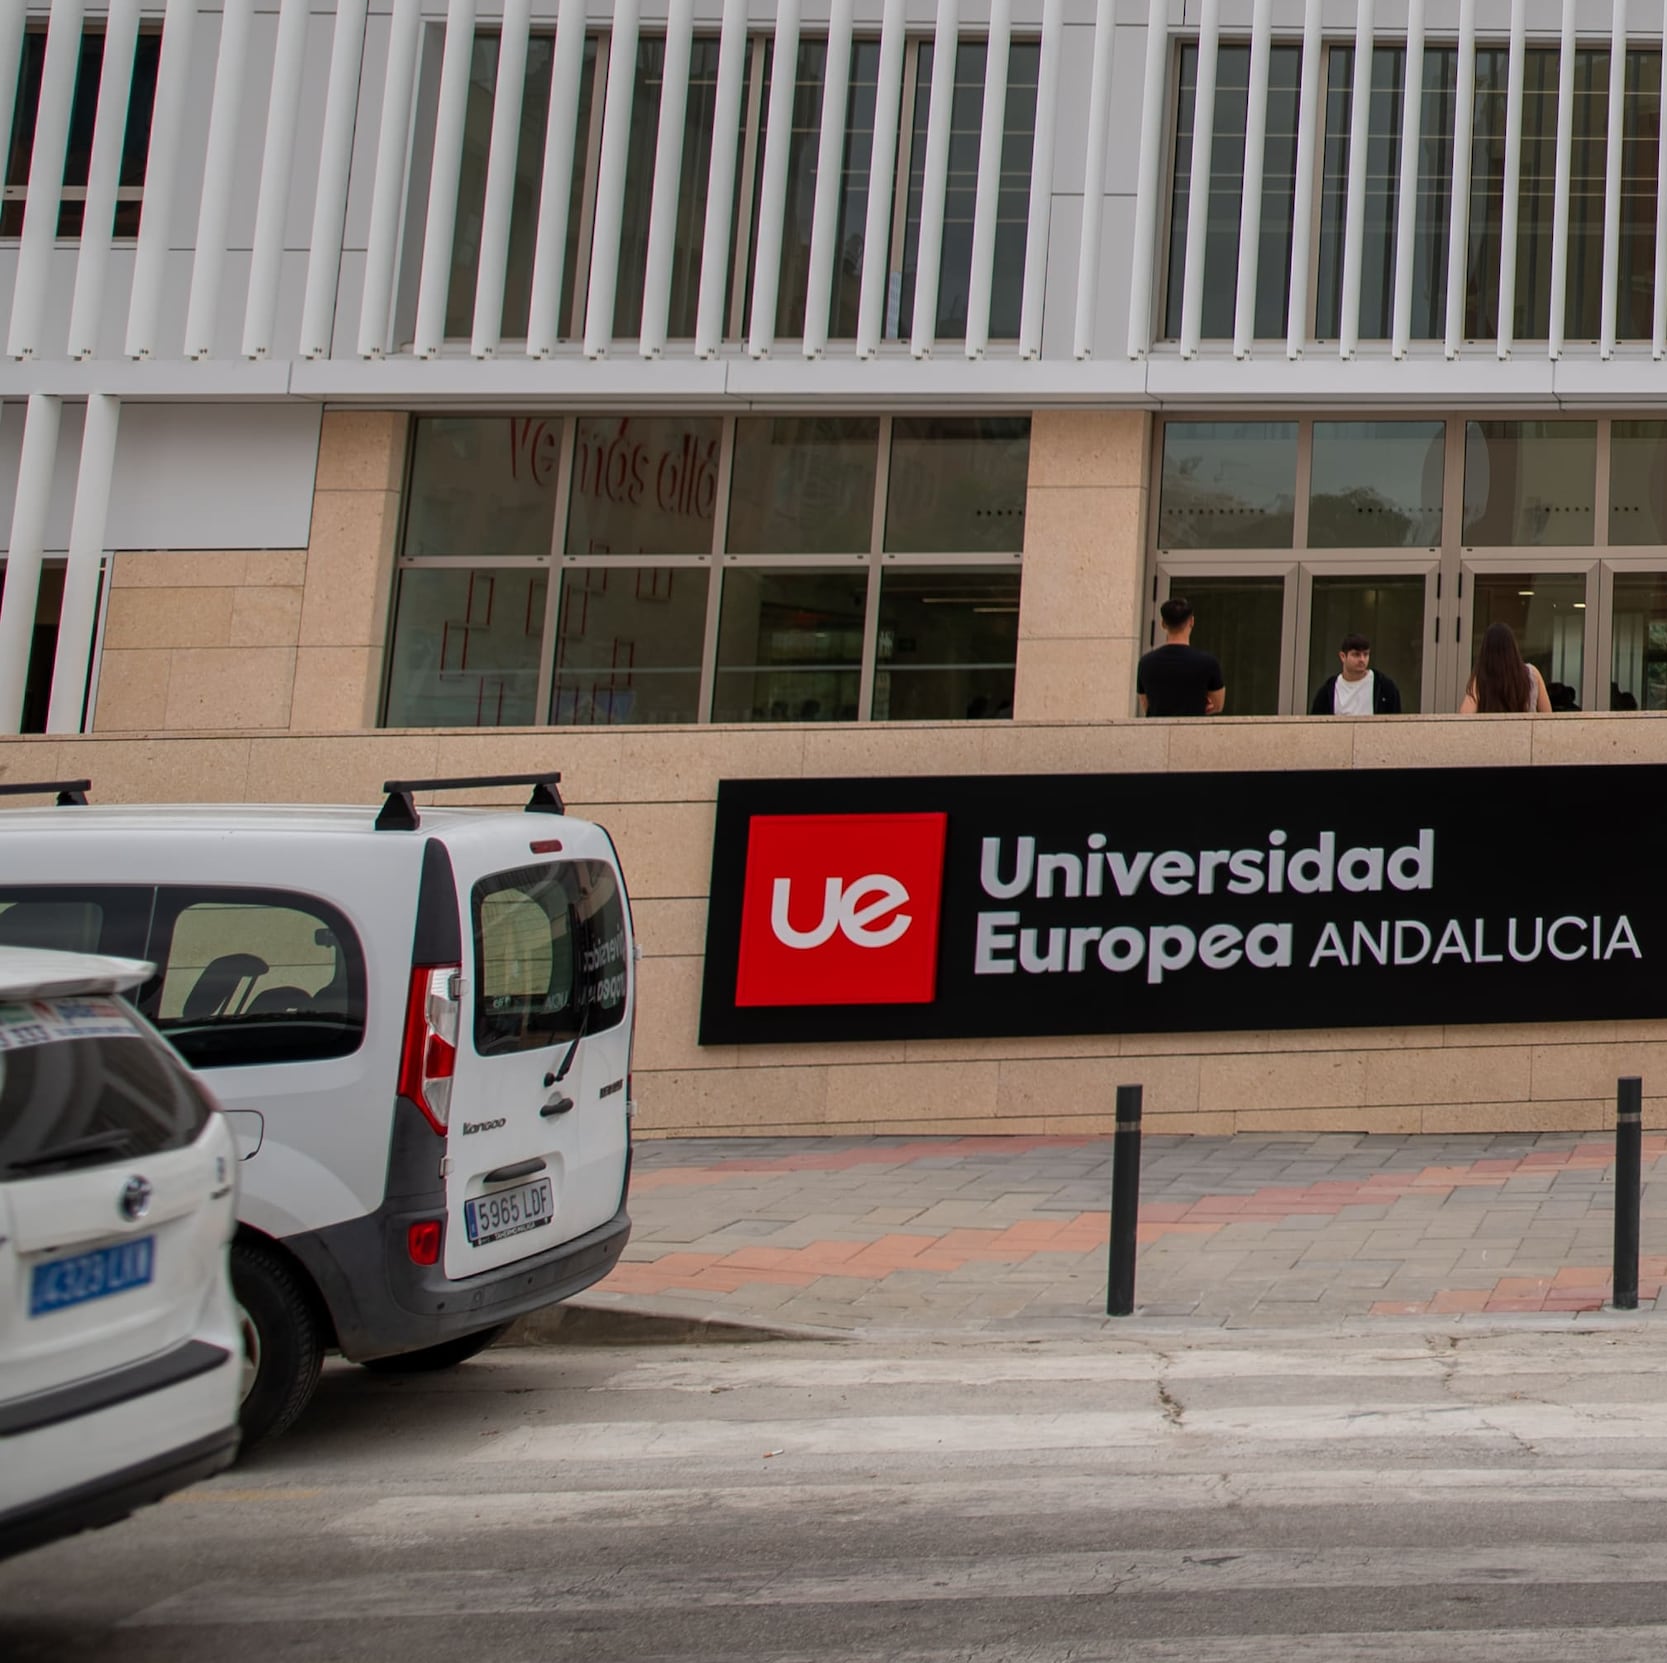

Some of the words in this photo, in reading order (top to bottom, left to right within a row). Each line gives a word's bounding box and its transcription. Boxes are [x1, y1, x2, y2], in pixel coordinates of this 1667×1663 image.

[978, 828, 1434, 899] Universidad
[771, 874, 913, 949] ue
[974, 911, 1293, 984] Europea
[1309, 915, 1643, 968] ANDALUCIA
[462, 1117, 507, 1136] Kangoo
[478, 1194, 520, 1231] 5965
[522, 1185, 548, 1219] LDF
